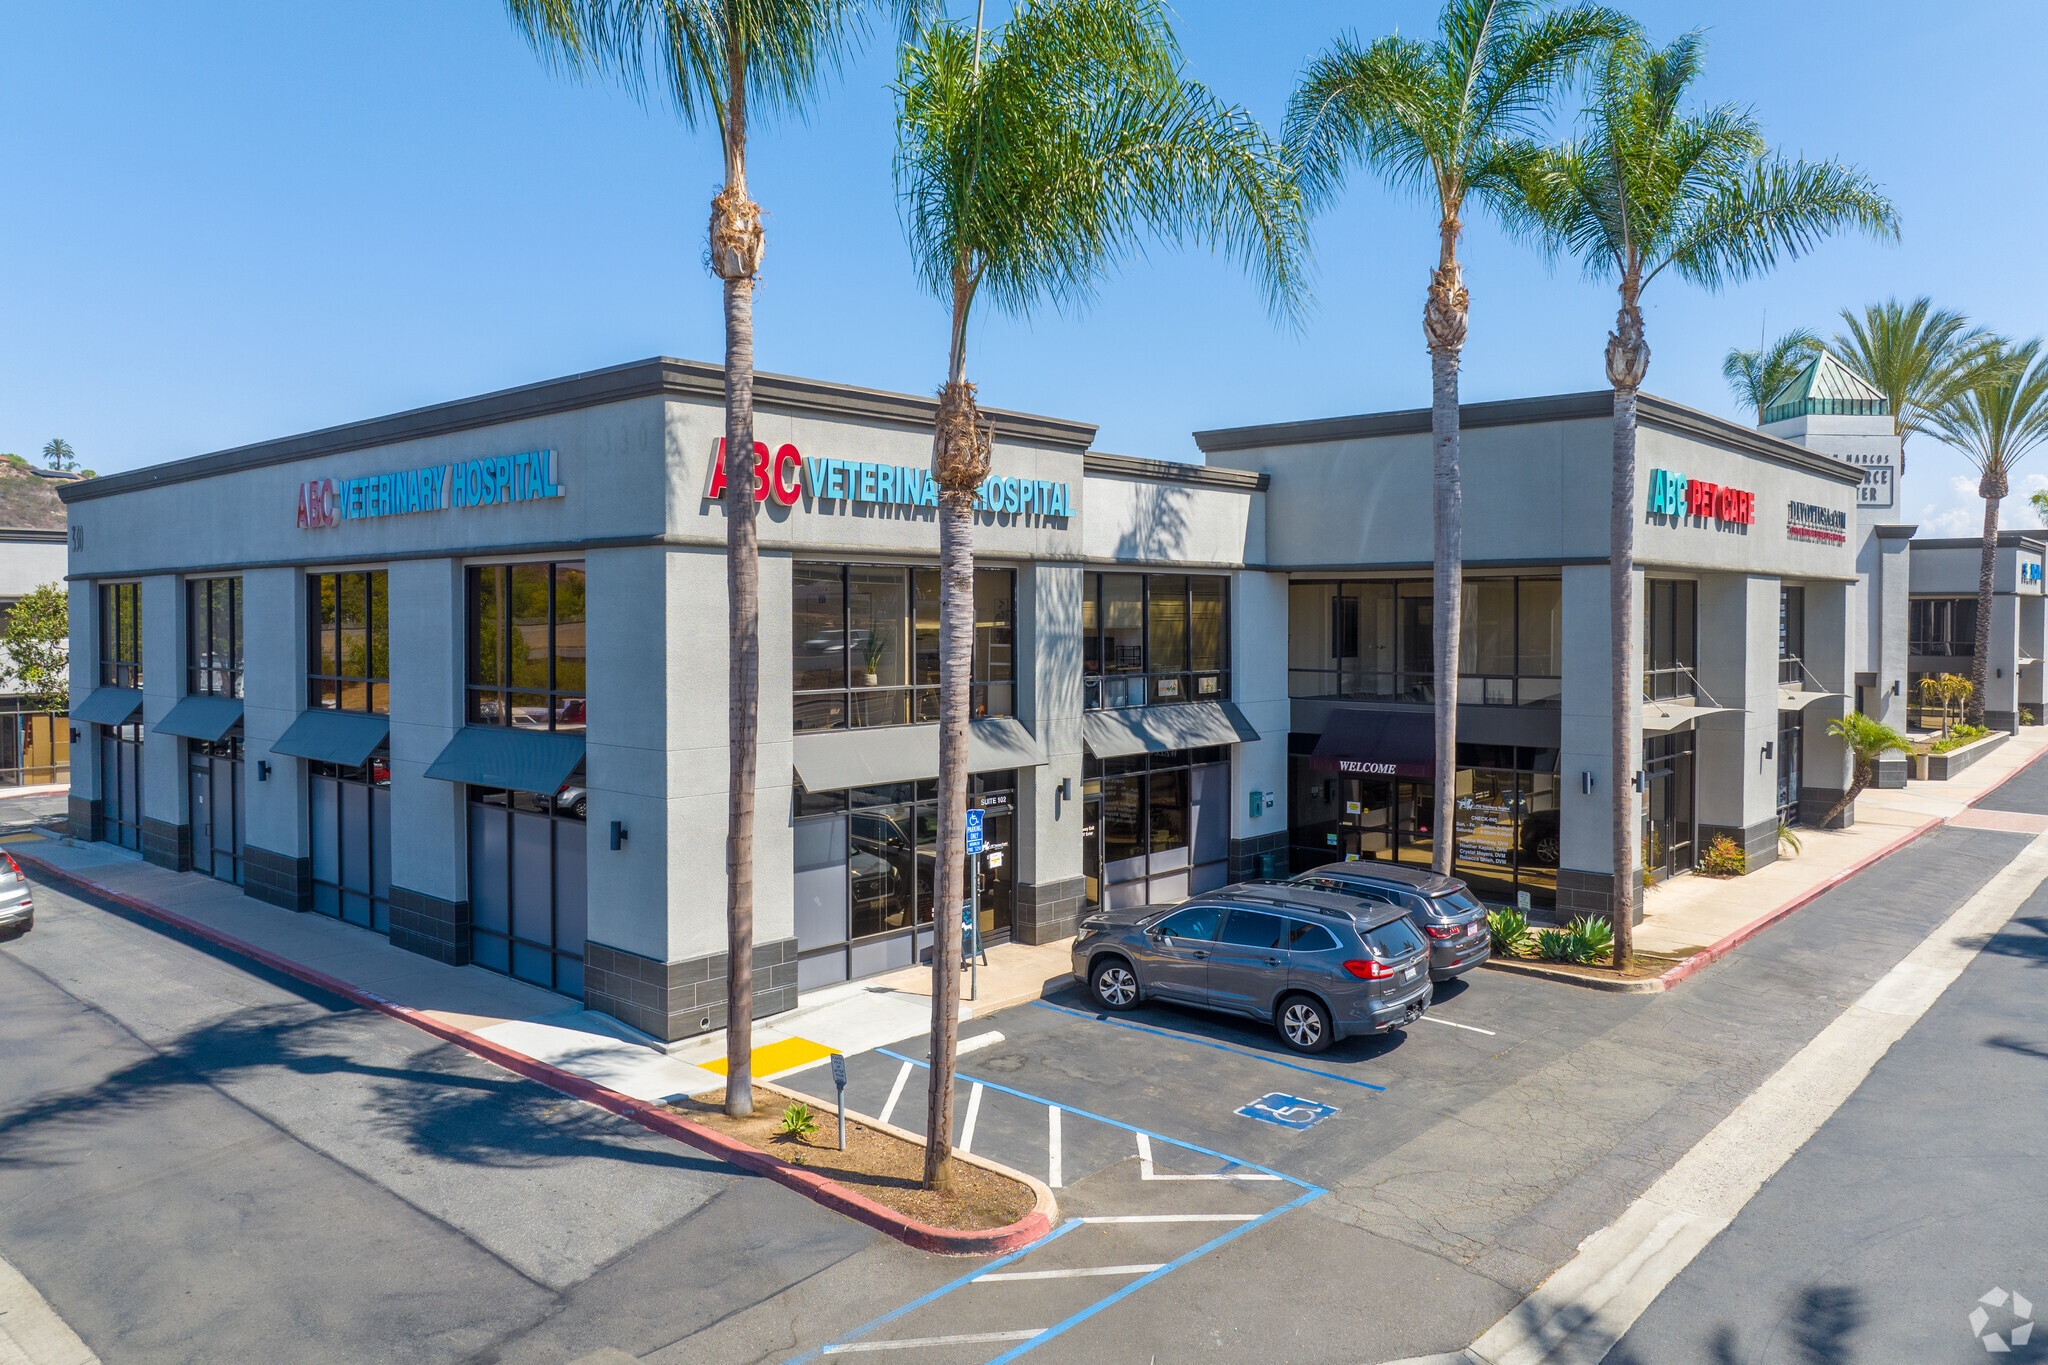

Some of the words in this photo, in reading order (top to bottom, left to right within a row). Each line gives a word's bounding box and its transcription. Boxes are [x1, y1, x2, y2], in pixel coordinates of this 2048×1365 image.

[1846, 454, 1889, 465] MARCOS
[297, 477, 336, 529] ABC
[339, 464, 448, 520] VETERINARY
[452, 449, 560, 508] HOSPITAL
[805, 455, 942, 508] VETERINA
[1650, 467, 1688, 518] ABC
[1691, 478, 1719, 518] PET
[1721, 485, 1755, 525] CARE
[1339, 760, 1396, 775] WELCOME
[981, 797, 997, 806] SUITE
